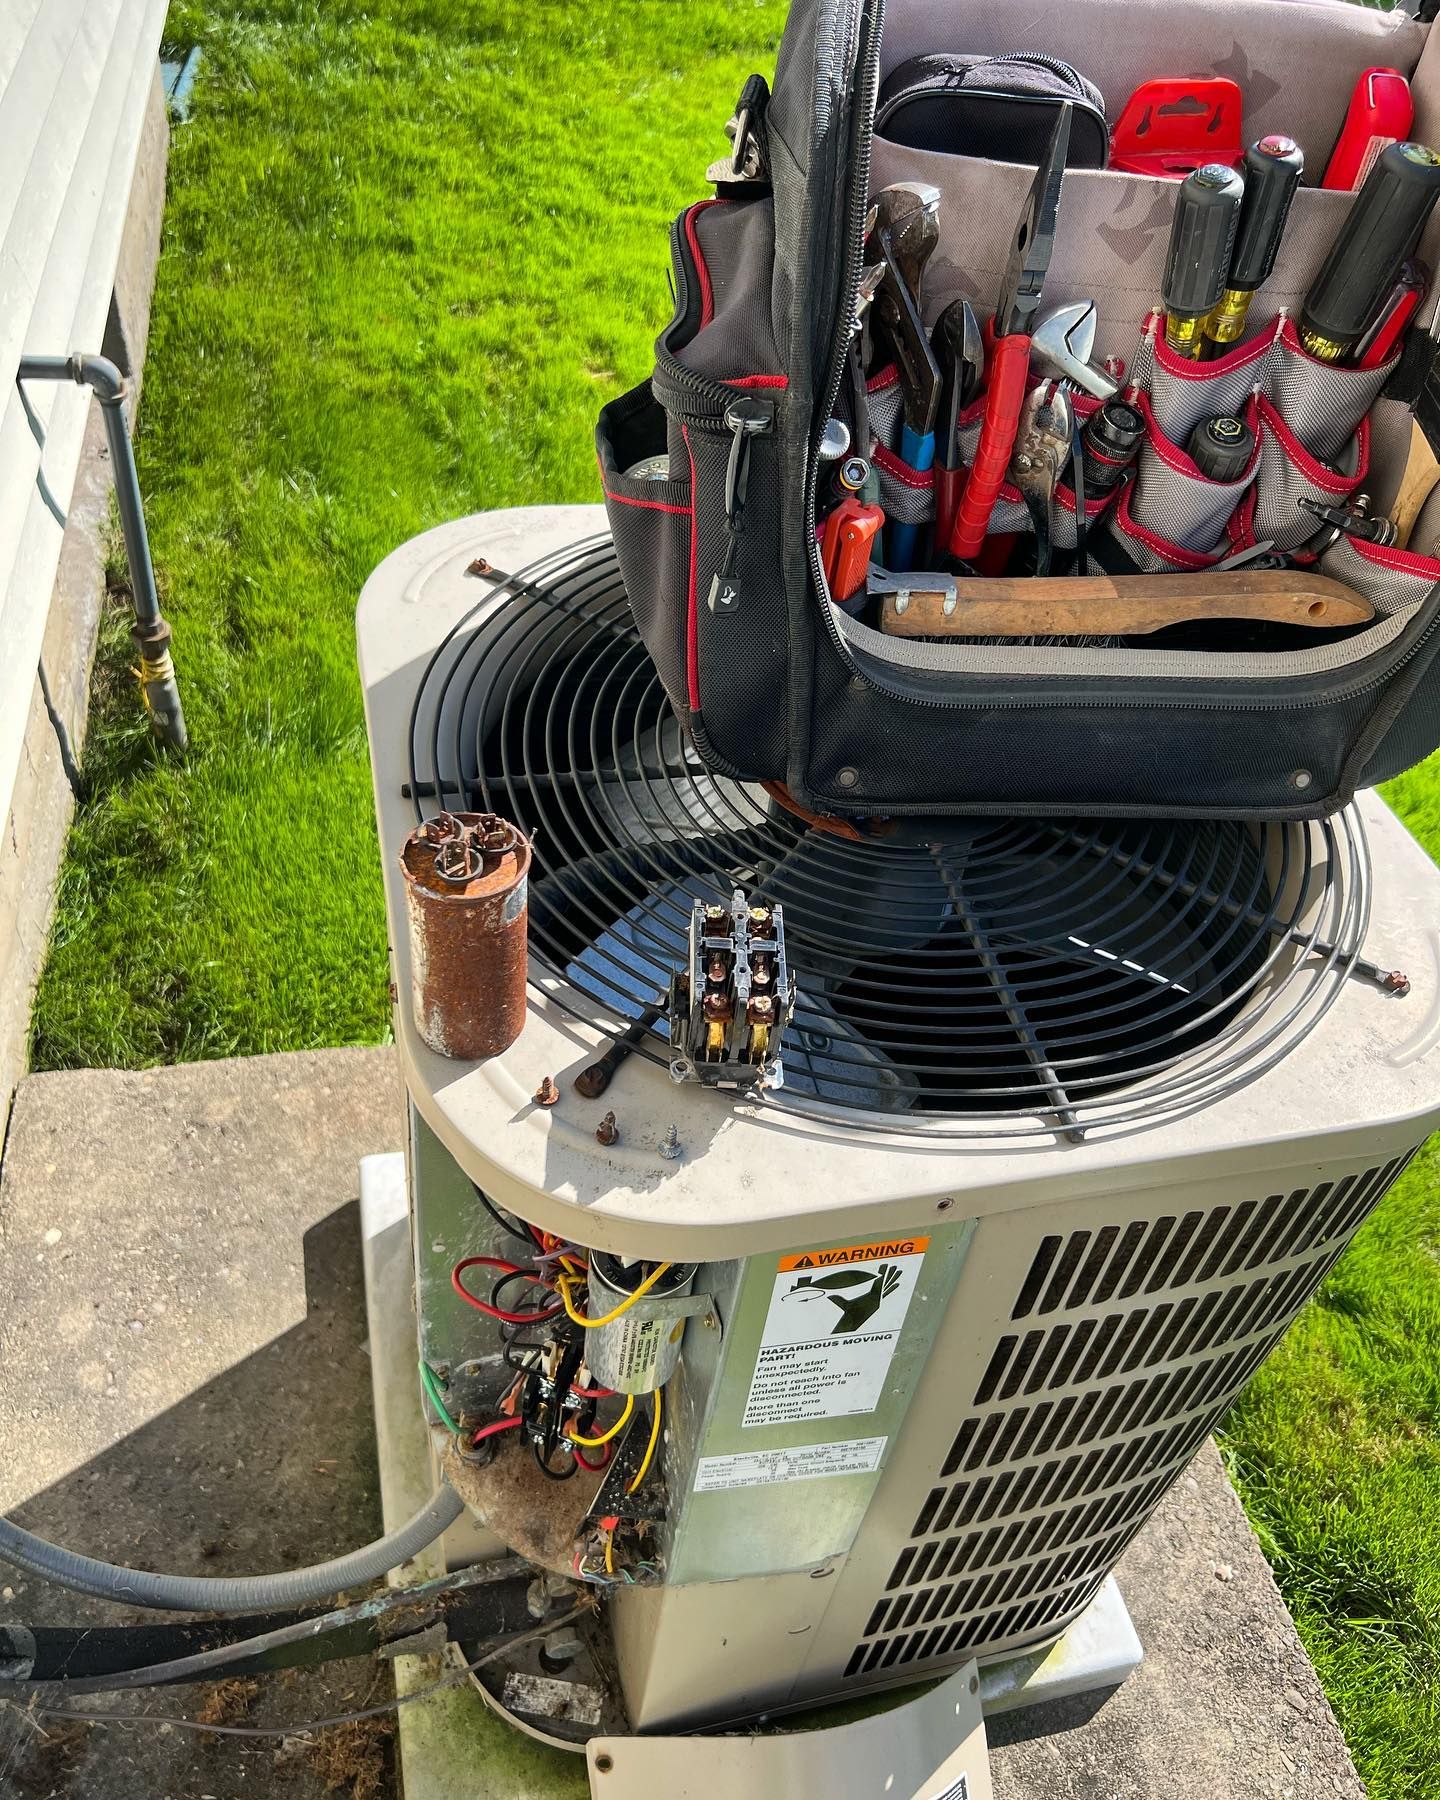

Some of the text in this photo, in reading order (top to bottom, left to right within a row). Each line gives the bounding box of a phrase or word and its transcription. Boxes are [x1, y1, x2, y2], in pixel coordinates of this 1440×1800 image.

[819, 1242, 914, 1265] WARNING
[761, 1334, 893, 1356] HAZARDOUS MOVING
[759, 1353, 795, 1363] PART!
[779, 1362, 801, 1370] may
[804, 1359, 829, 1367] start
[755, 1366, 826, 1379] unexpectedly.
[790, 1375, 819, 1384] reach
[822, 1373, 842, 1381] into
[752, 1387, 785, 1396] unless
[802, 1381, 835, 1391] power
[750, 1389, 821, 1402] disconnected.
[748, 1403, 773, 1411] More
[776, 1400, 798, 1408] than
[744, 1417, 766, 1425] may
[784, 1410, 828, 1420] required.
[746, 1407, 802, 1418] disconnect
